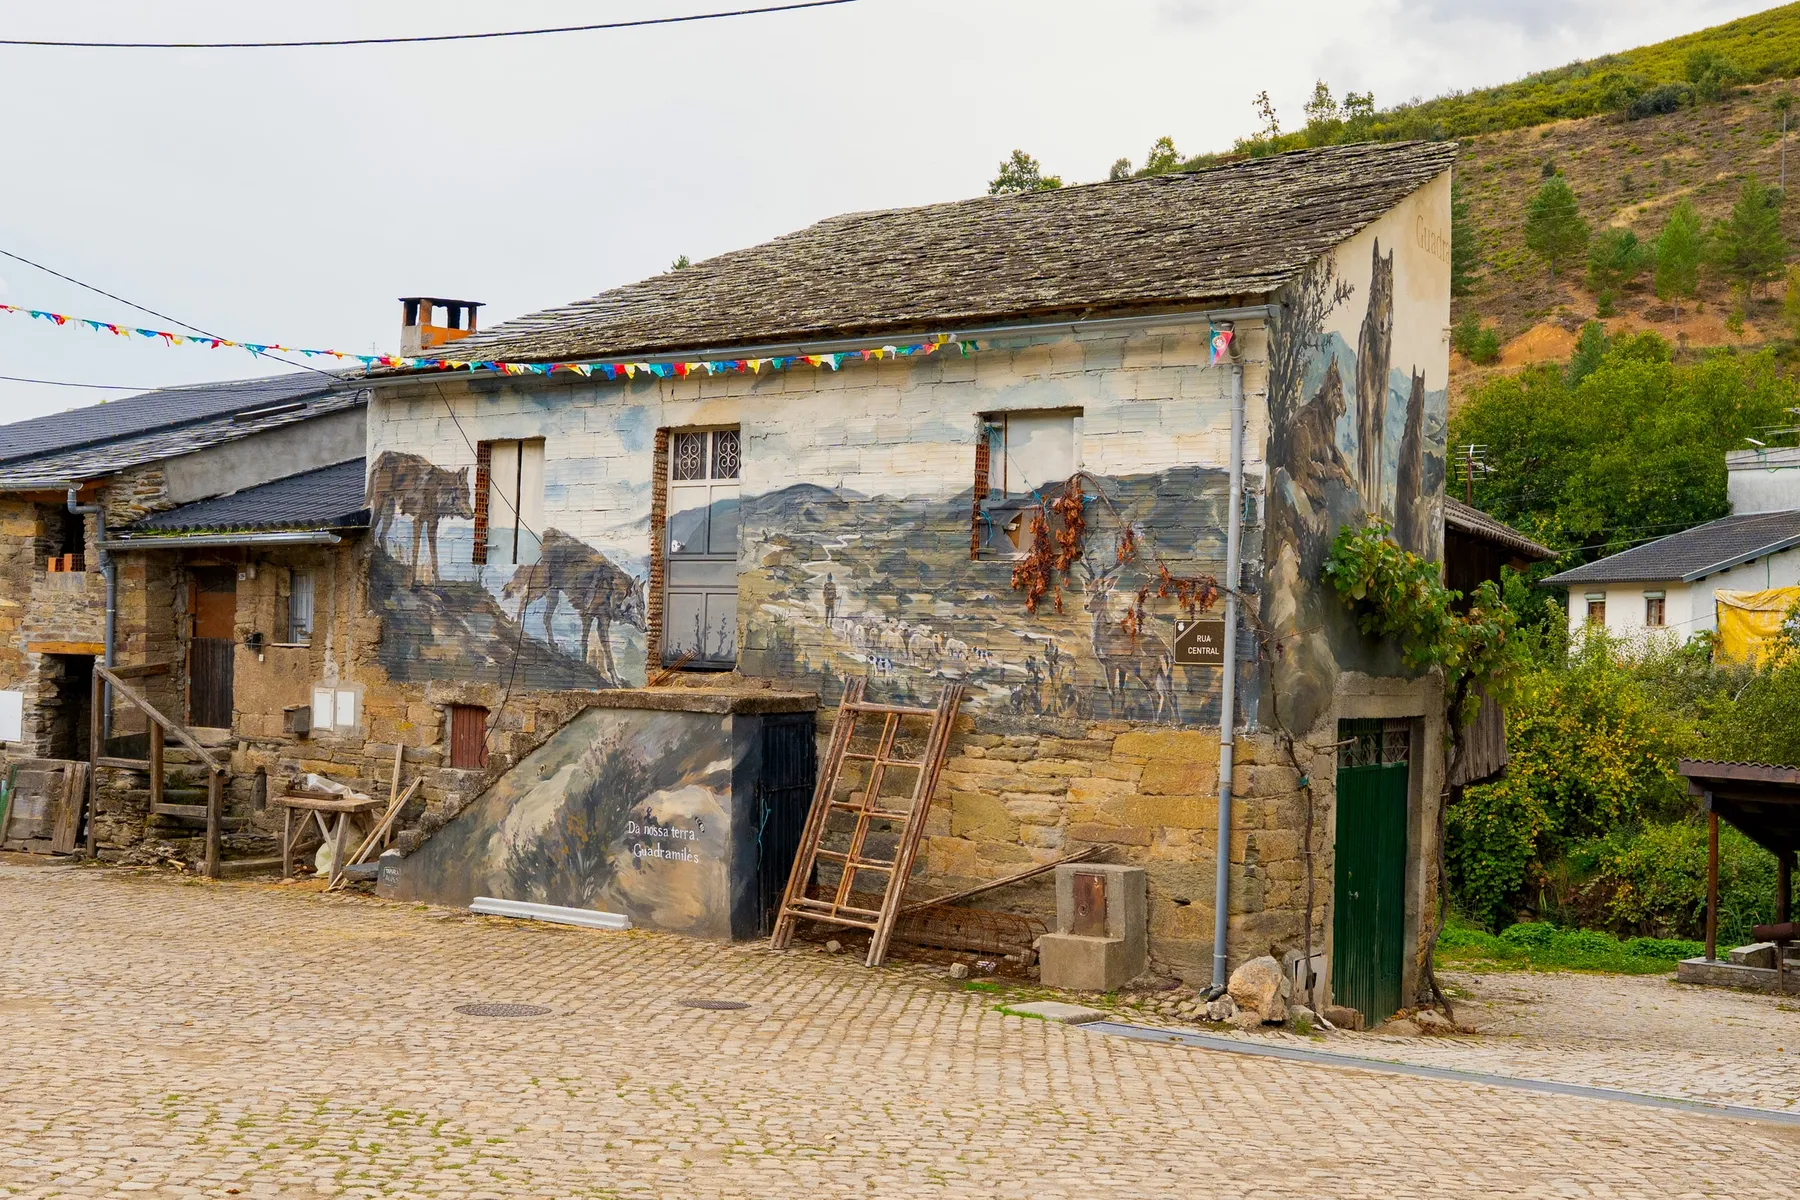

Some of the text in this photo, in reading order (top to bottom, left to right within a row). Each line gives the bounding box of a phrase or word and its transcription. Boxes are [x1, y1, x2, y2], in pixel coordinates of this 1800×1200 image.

[1196, 634, 1212, 643] RUA
[1187, 646, 1220, 655] CENTRAL
[628, 820, 640, 834] Da
[644, 825, 669, 837] nossa
